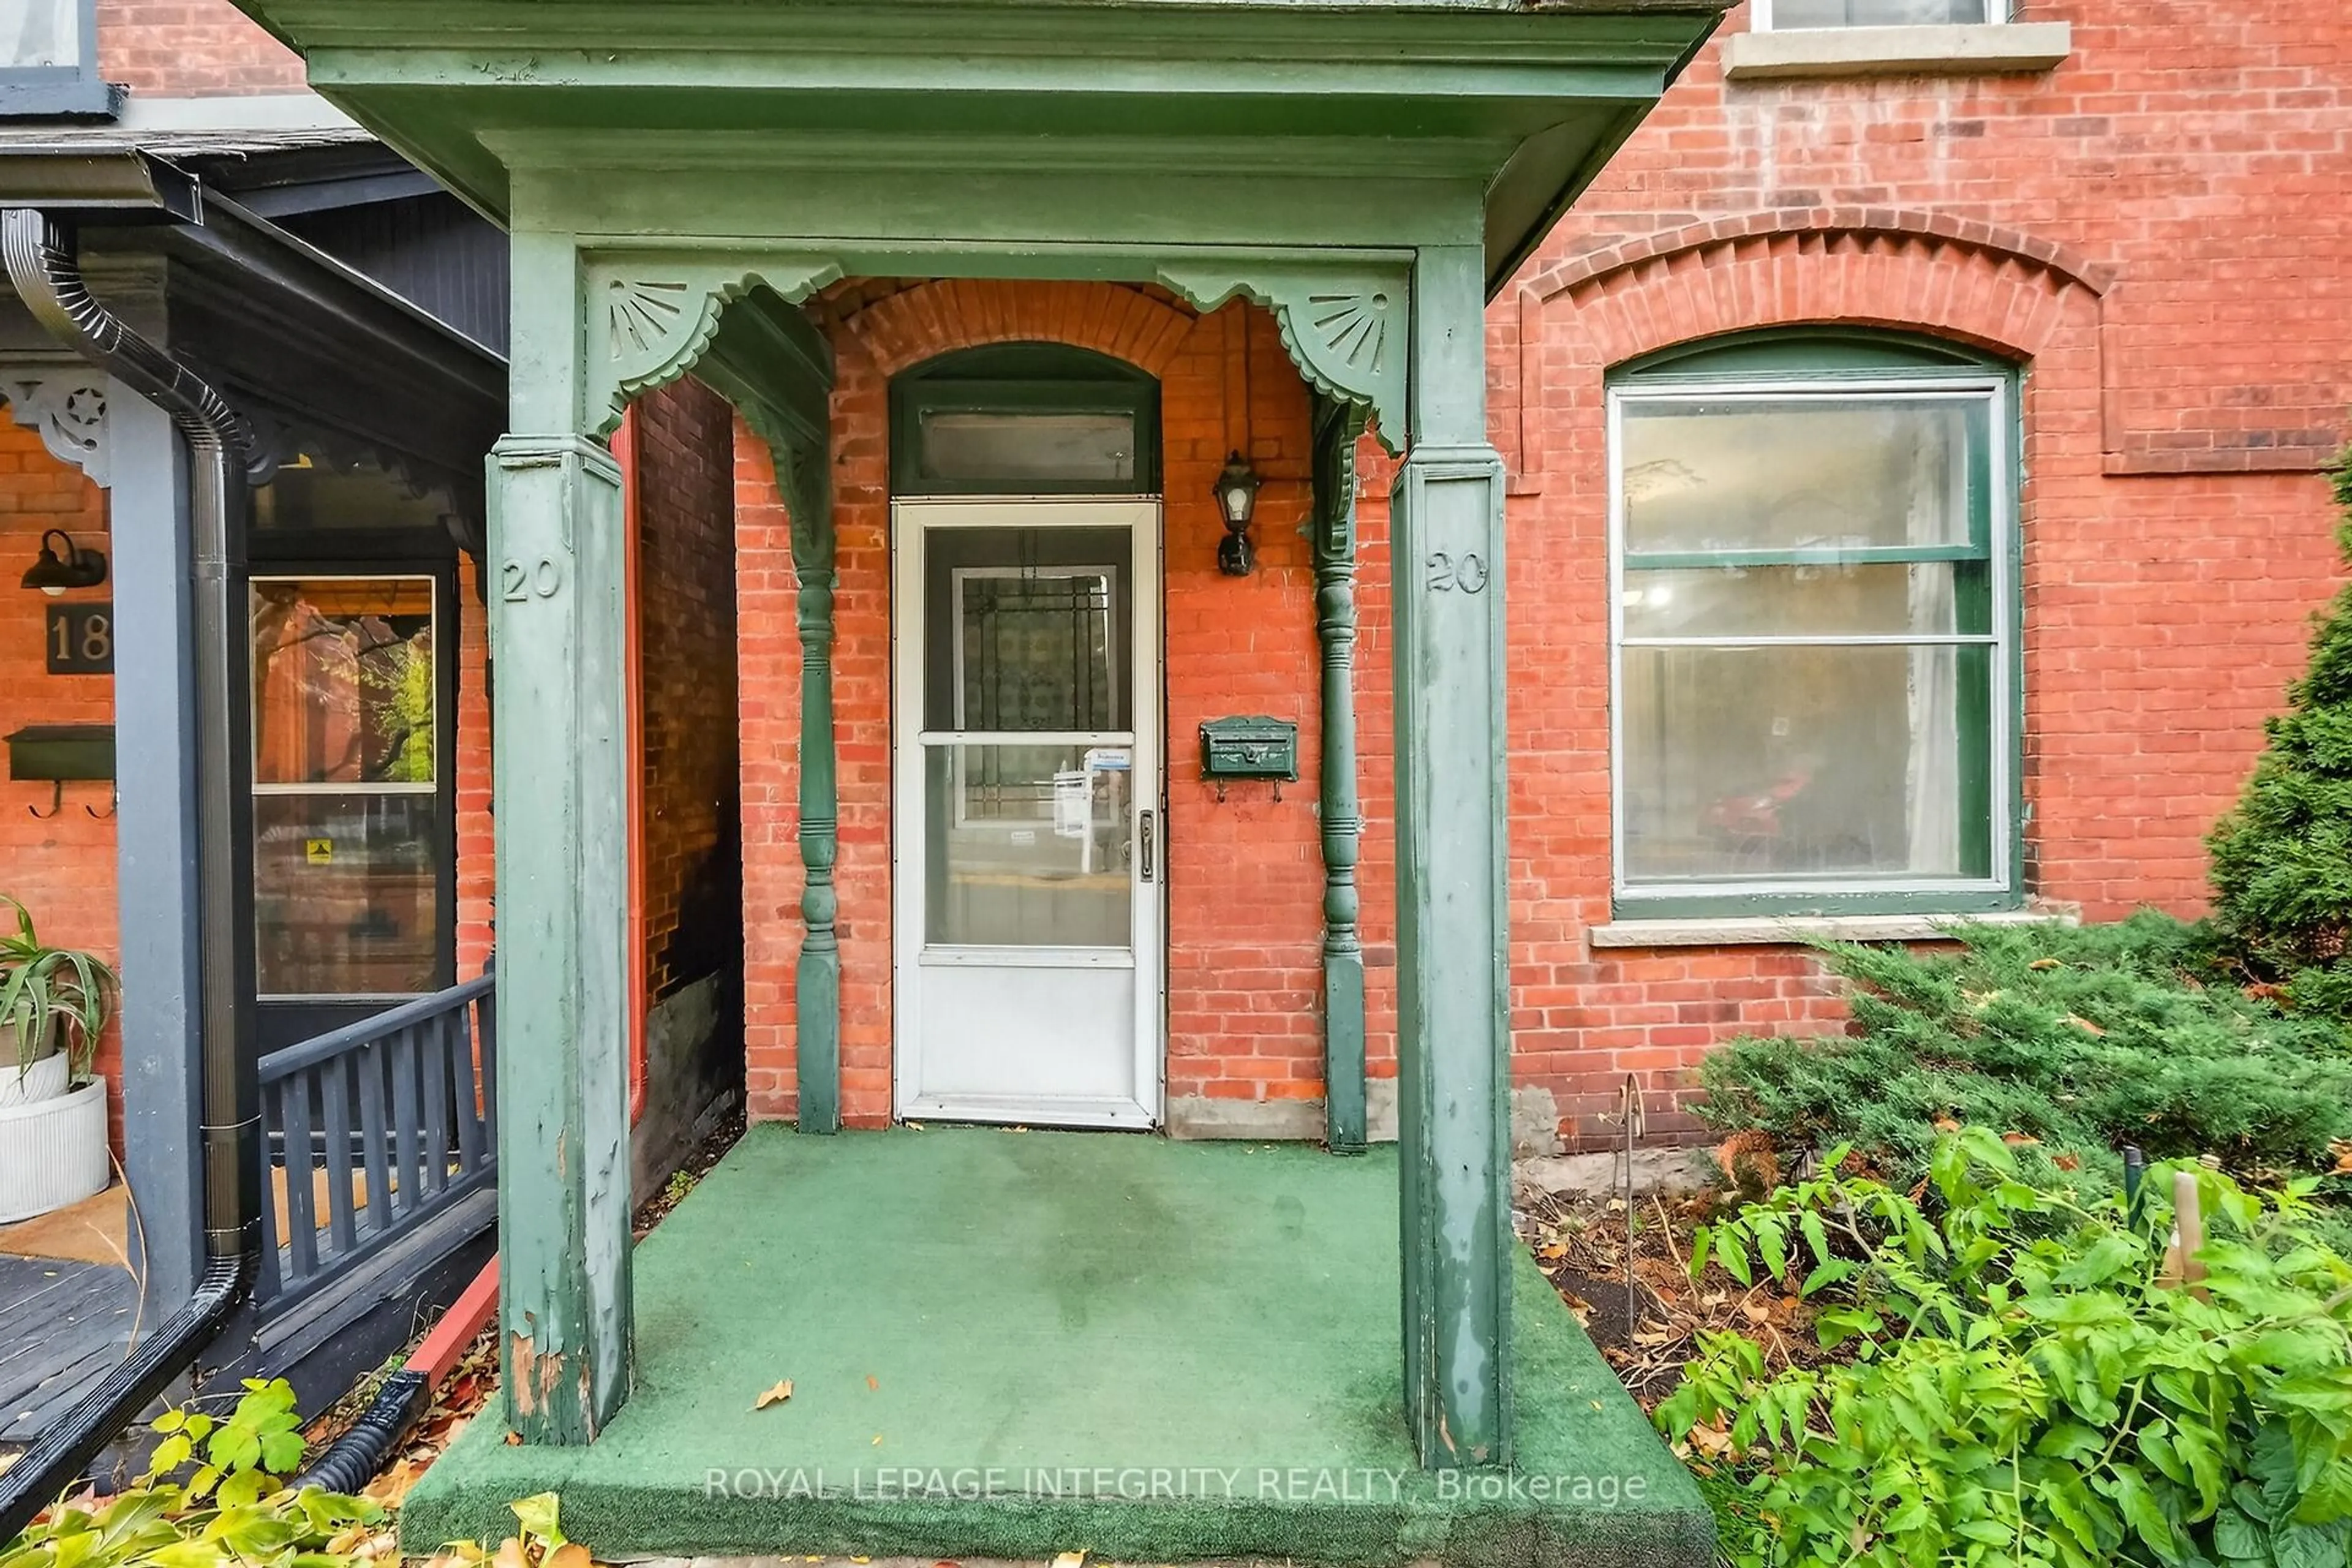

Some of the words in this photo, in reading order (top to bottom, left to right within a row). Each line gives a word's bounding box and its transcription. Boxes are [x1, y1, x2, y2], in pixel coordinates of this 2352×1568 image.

[502, 556, 562, 603] 20
[1425, 551, 1488, 594] 20
[51, 614, 110, 660] 18
